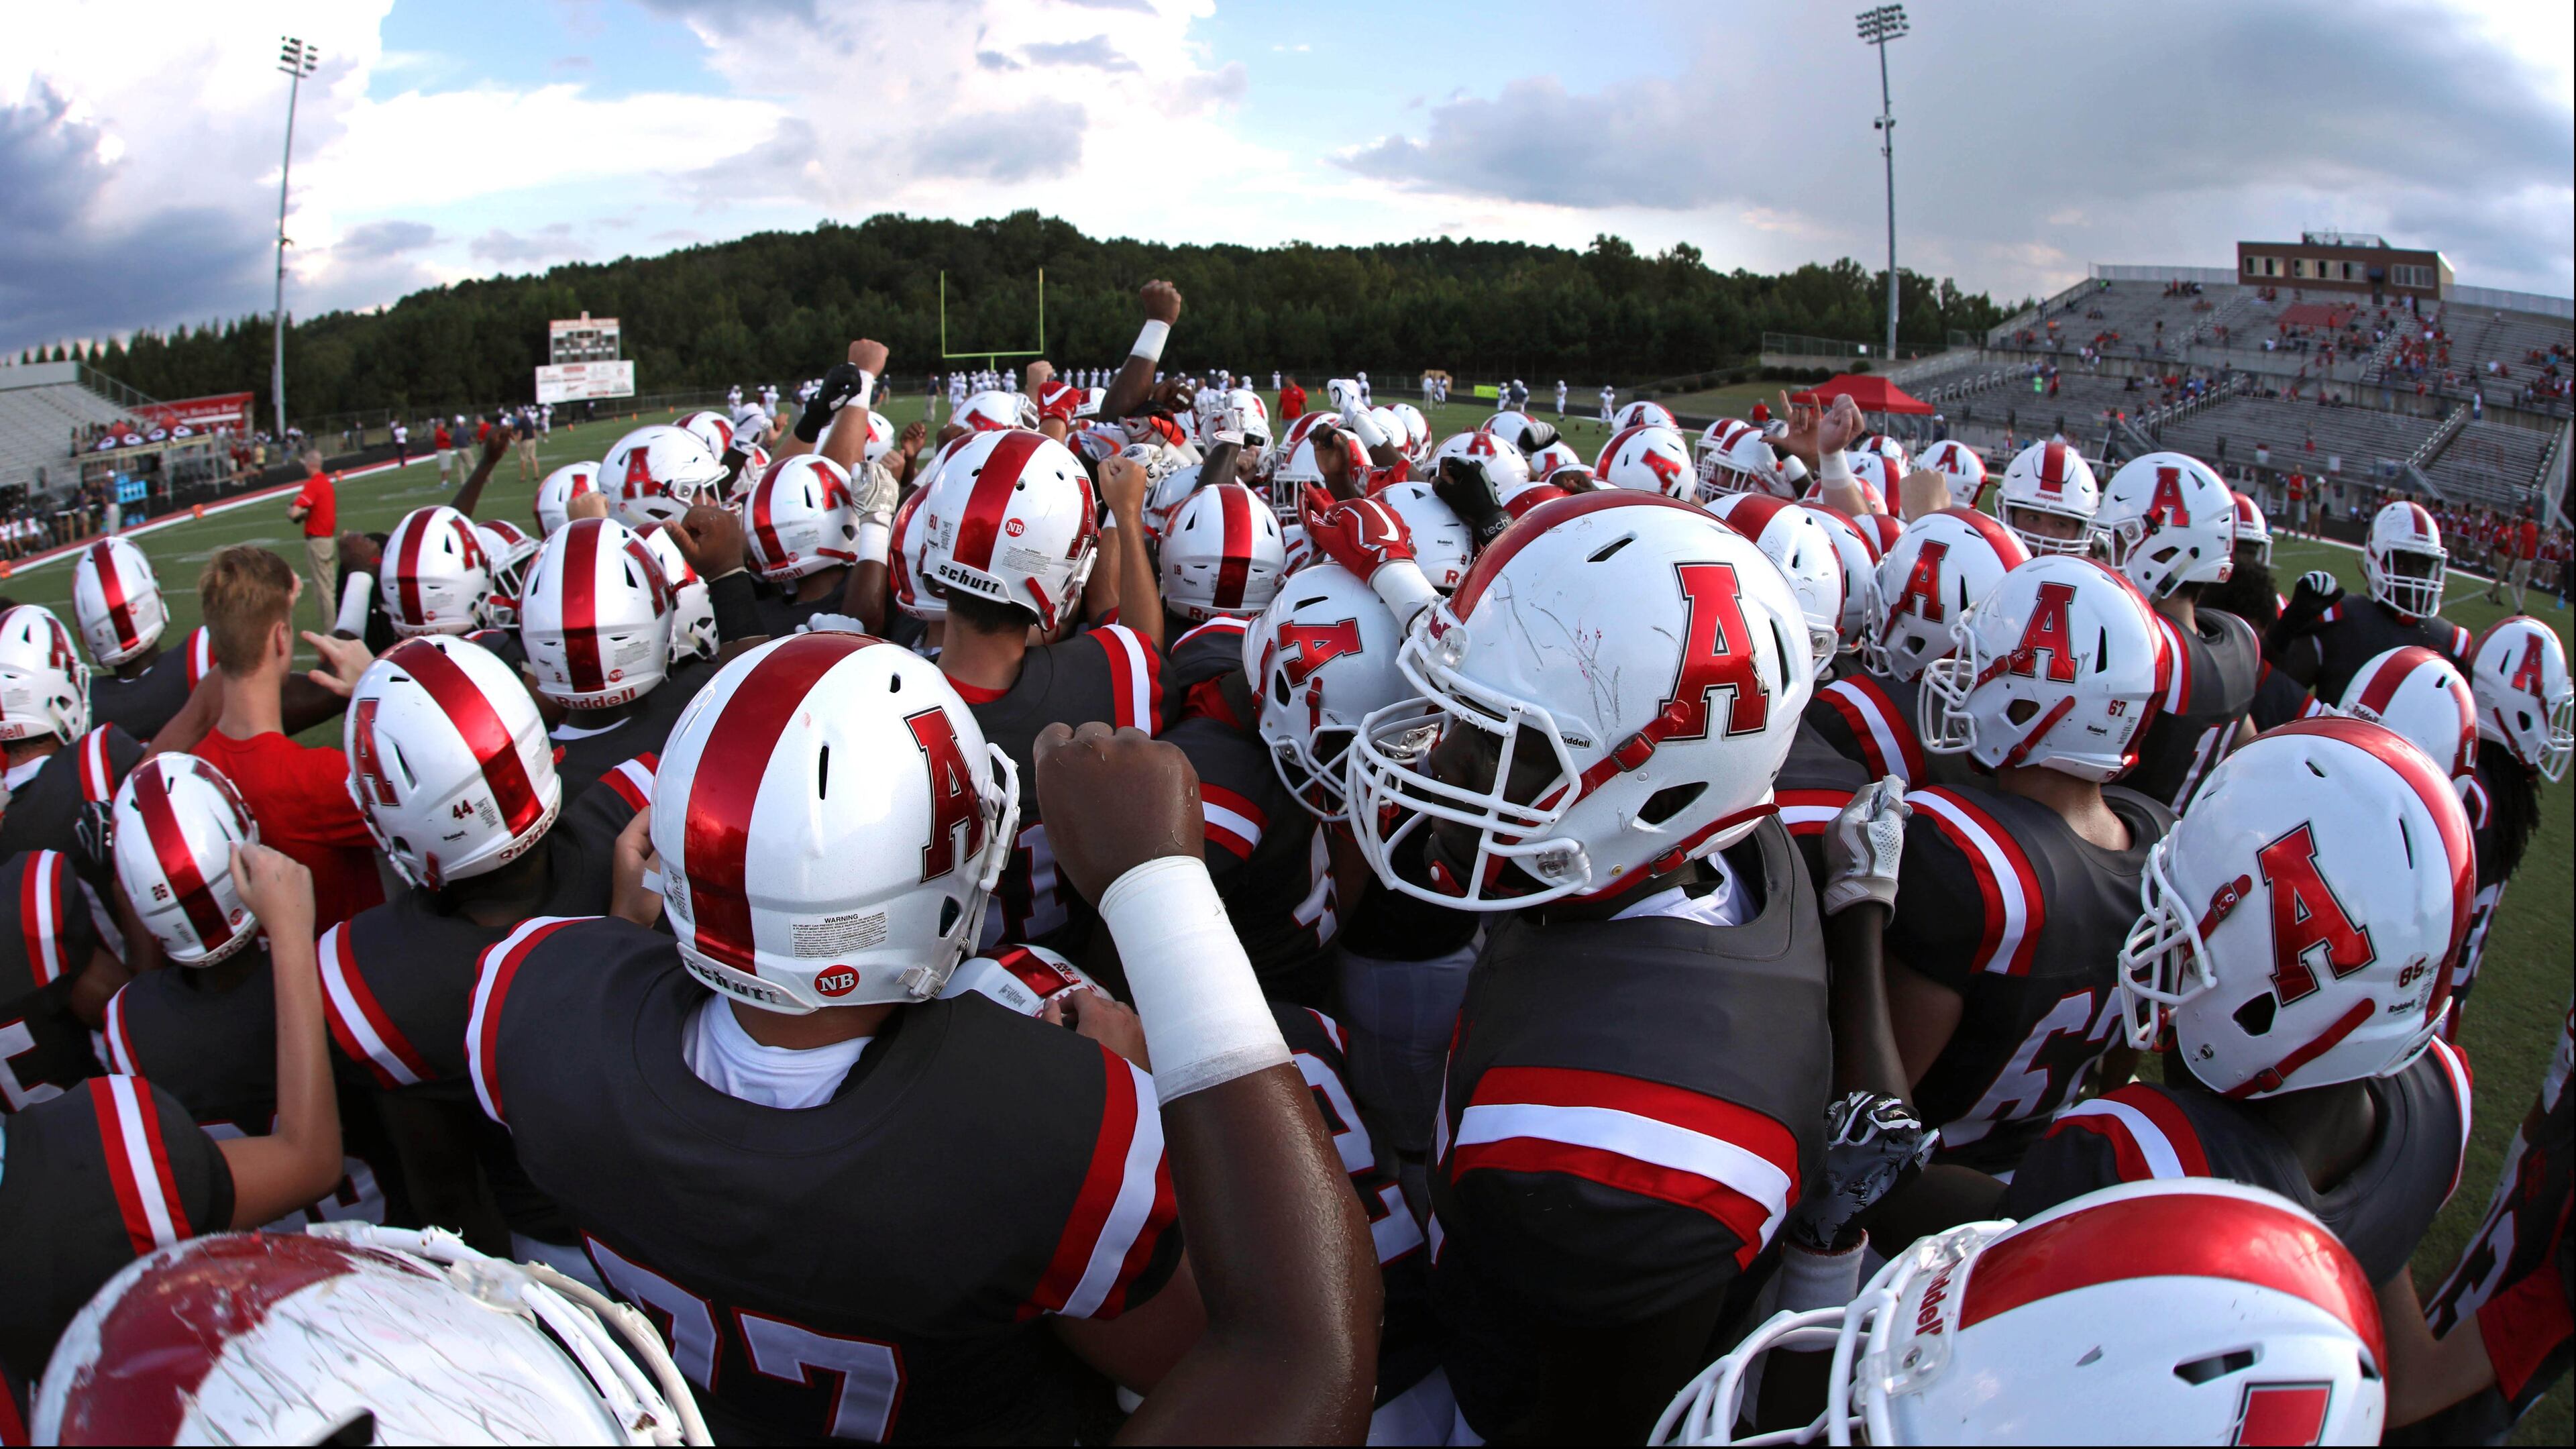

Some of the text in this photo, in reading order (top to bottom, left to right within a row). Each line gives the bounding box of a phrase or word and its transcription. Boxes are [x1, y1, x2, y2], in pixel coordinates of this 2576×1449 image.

[1466, 433, 1497, 456] A
[1935, 444, 1960, 474] A
[623, 446, 662, 500] A
[806, 461, 854, 511] A
[1641, 447, 1682, 495] A
[929, 514, 937, 530] 81
[2149, 467, 2190, 527] A
[447, 515, 486, 572] A
[1006, 521, 1024, 535] NB
[939, 564, 1000, 594] schutt
[1899, 539, 1949, 624] A
[1277, 617, 1364, 688] A
[1658, 561, 1770, 742] A
[2010, 581, 2079, 684] A
[2511, 631, 2545, 698] A
[555, 687, 636, 710] Riddell
[2108, 700, 2127, 717] 67
[354, 696, 400, 807] A
[452, 799, 474, 820] 44
[900, 704, 986, 885] A
[824, 914, 858, 924] WARNING
[2255, 820, 2377, 1008] A
[683, 953, 781, 1004] schutt
[819, 973, 855, 991] NB
[2399, 957, 2426, 988] 85
[580, 1229, 908, 1444] 77
